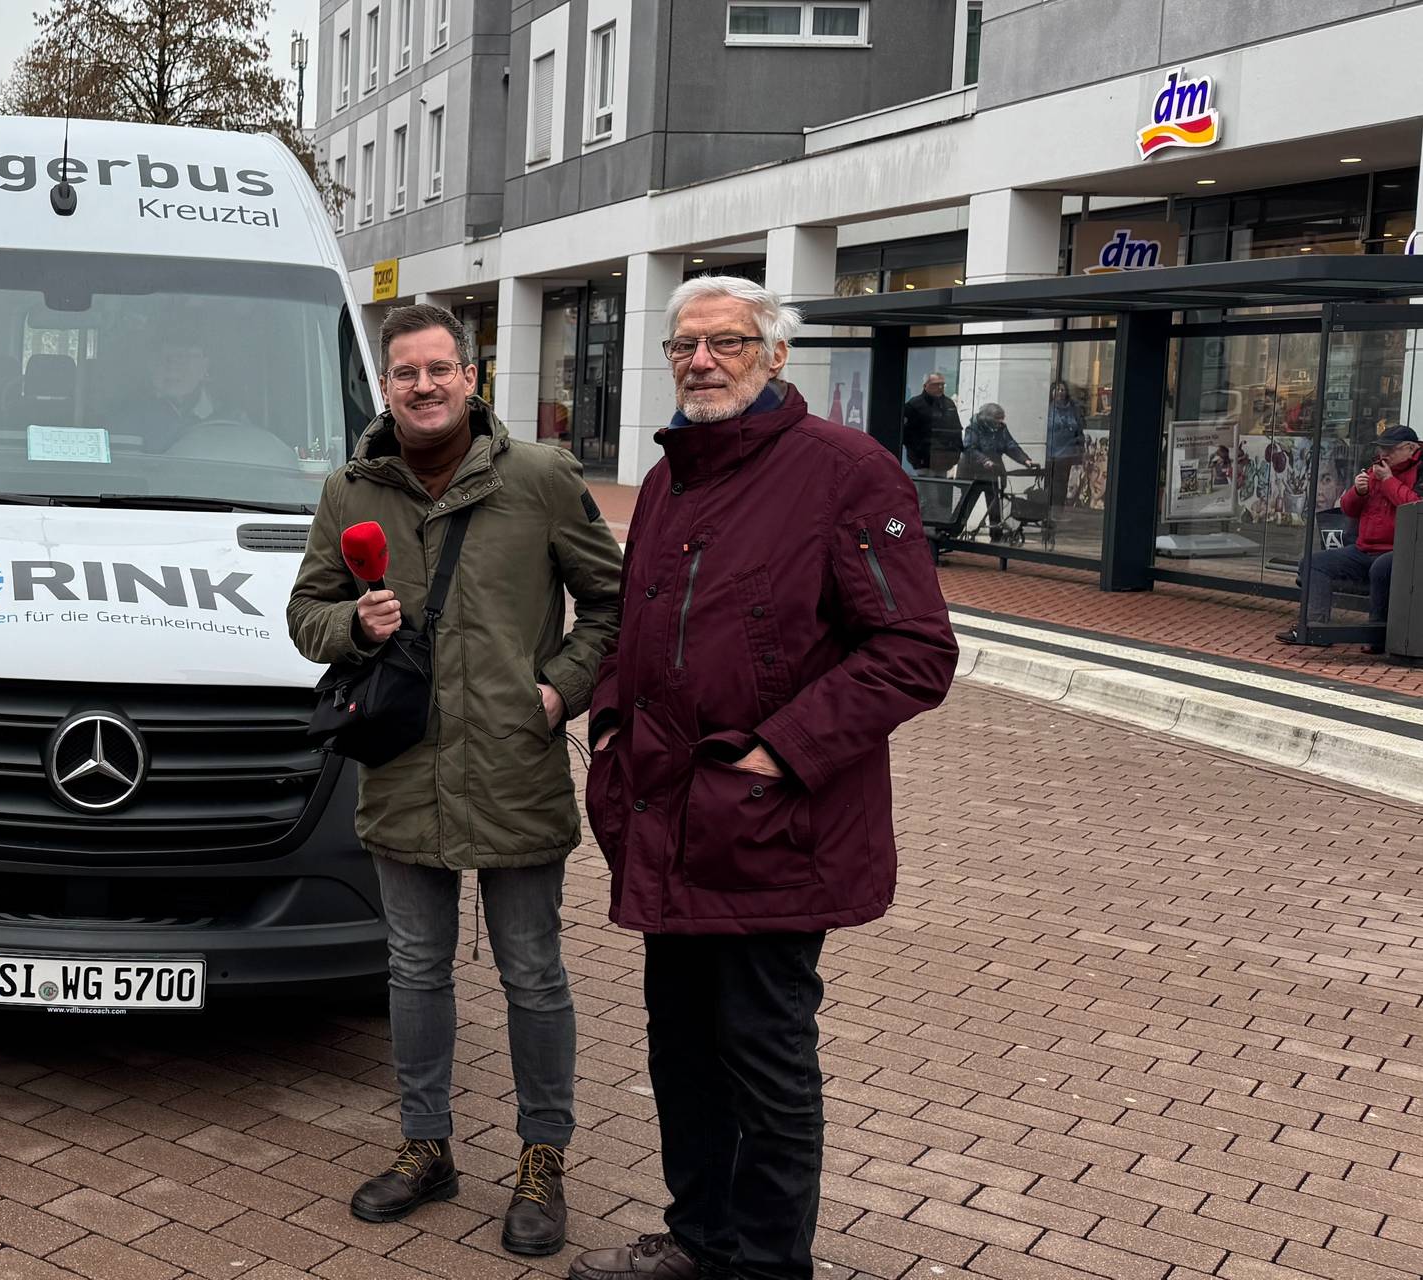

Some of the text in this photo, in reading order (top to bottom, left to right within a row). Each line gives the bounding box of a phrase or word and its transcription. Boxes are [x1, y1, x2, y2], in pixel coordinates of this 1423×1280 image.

[1154, 72, 1209, 124] dm
[138, 197, 280, 228] Kreuztal
[1102, 232, 1159, 267] dm
[25, 610, 55, 622] für
[61, 610, 89, 622] die
[96, 610, 271, 640] Getränkeindustrie
[62, 966, 103, 1001] WG
[113, 967, 197, 1002] 5700
[46, 1006, 127, 1014] www.vdlbuscoach.com
